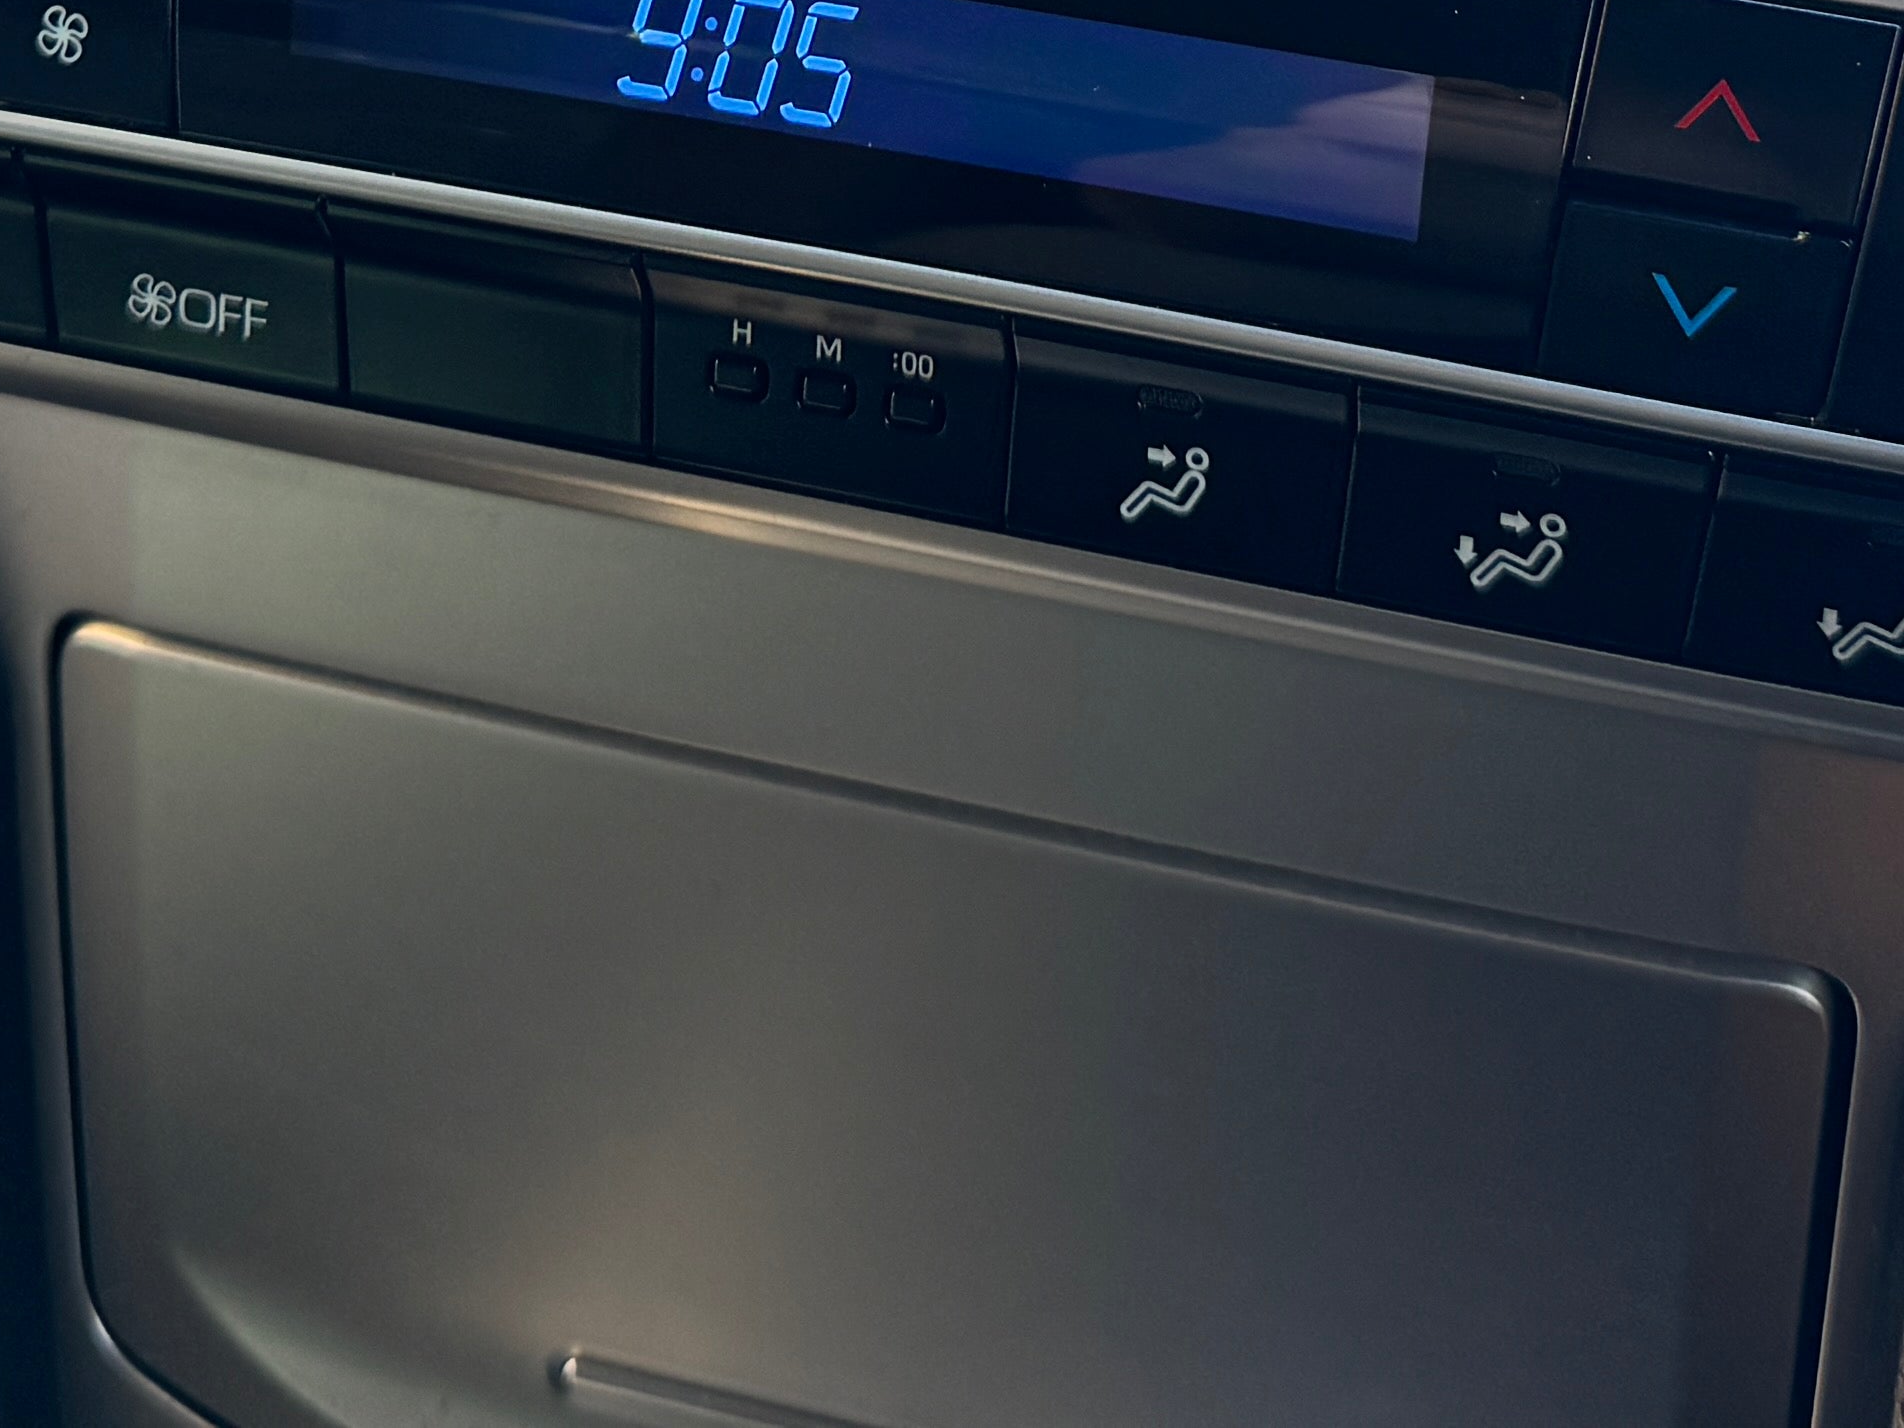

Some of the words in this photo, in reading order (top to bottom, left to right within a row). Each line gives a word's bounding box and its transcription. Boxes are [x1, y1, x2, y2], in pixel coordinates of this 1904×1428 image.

[177, 288, 269, 338] OFF
[731, 319, 753, 347] H
[816, 335, 842, 364] M
[892, 351, 935, 380] :00
